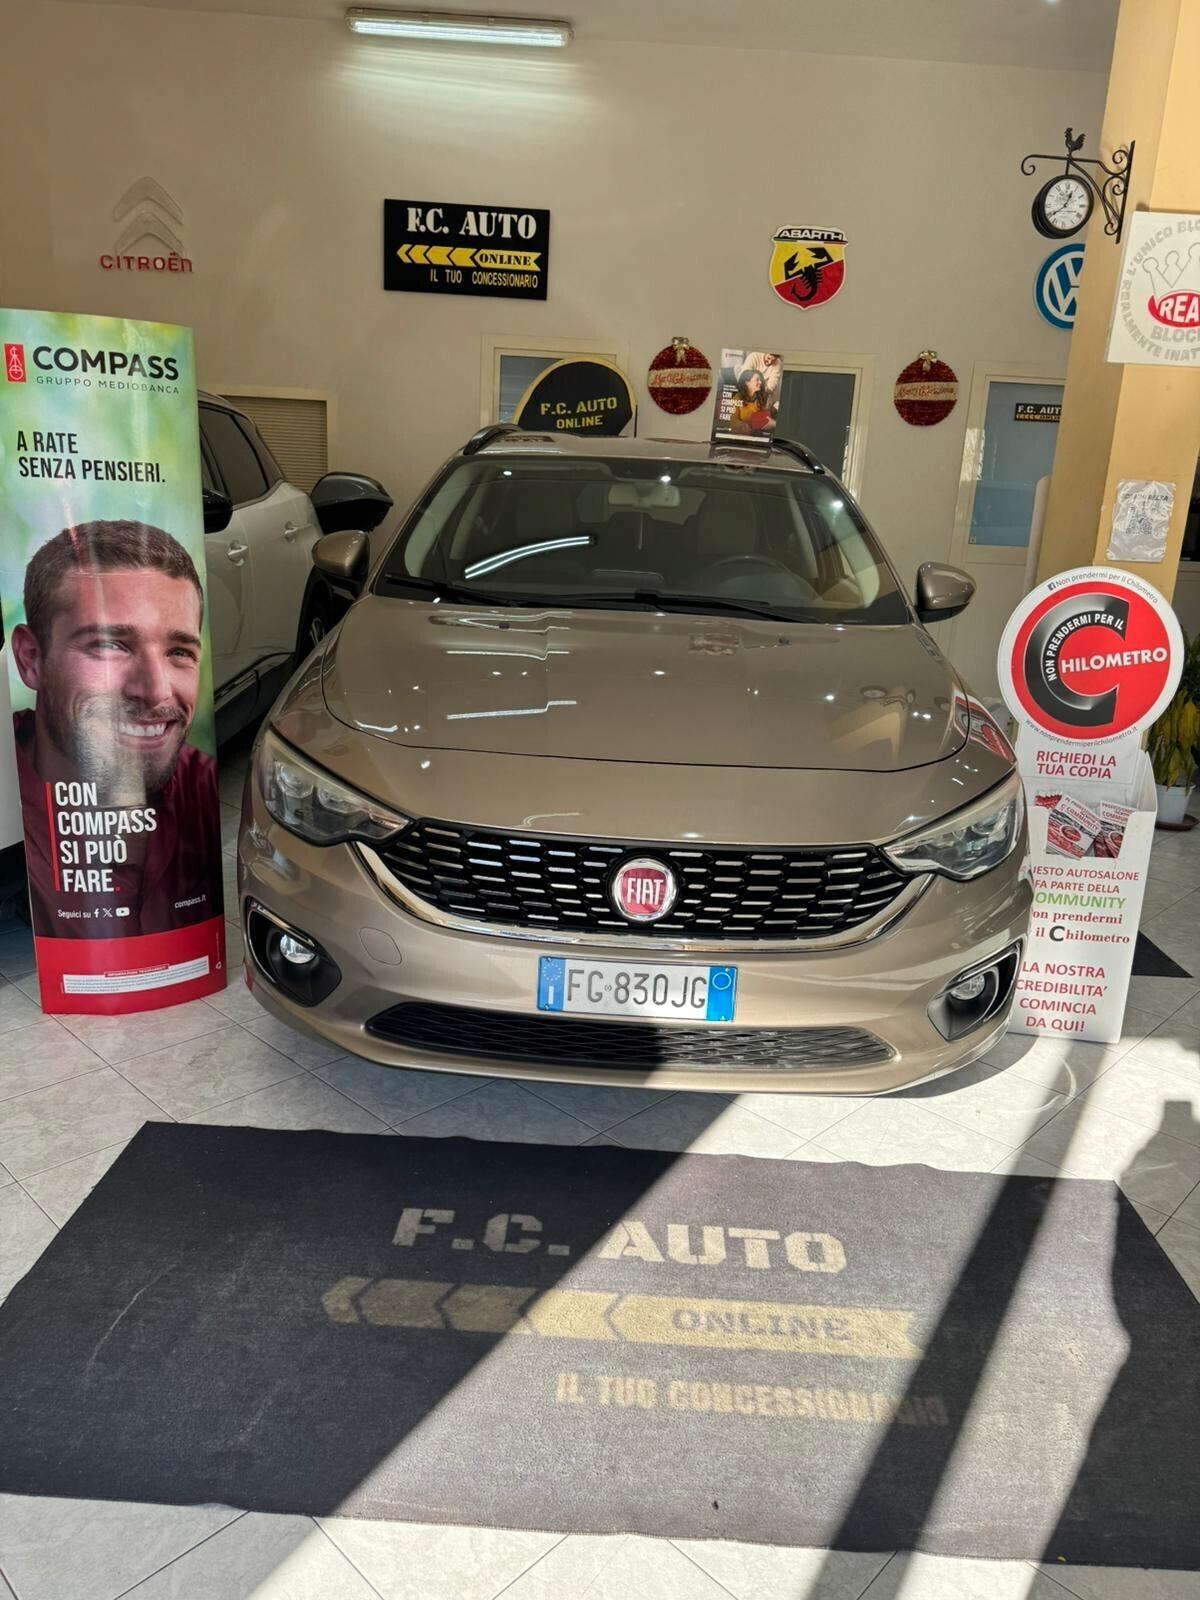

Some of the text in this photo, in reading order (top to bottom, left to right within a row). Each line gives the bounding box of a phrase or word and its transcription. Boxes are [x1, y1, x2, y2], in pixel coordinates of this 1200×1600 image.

[406, 207, 537, 239] F.C. AUTO
[779, 229, 842, 240] ABARTH
[479, 253, 531, 266] ONLINE
[430, 268, 539, 289] IL TUO CONCESSIONARIO
[1151, 325, 1200, 343] BLOC
[32, 346, 180, 381] COMPASS
[37, 376, 180, 394] GRUPPO MEDIOBANCA
[540, 397, 618, 416] F.C. AUTO
[1040, 406, 1061, 414] AUT
[556, 415, 603, 430] ONLINE
[17, 431, 78, 454] A RATE
[18, 456, 166, 483] SENZA PENSIERI.
[1055, 578, 1071, 587] Non
[1071, 572, 1108, 583] prendermi
[1109, 574, 1120, 583] per
[1045, 613, 1124, 682] NON PRENDERMI PER IL
[1036, 750, 1117, 767] RICHIEDI LA
[1037, 763, 1112, 779] TUA COPIA
[54, 781, 98, 807] CON
[57, 808, 158, 836] COMPASS
[59, 834, 128, 864] SI PUÒ
[1066, 868, 1140, 881] AUTOSALONE
[627, 877, 664, 905] FIAT
[1051, 880, 1084, 892] PARTE
[1087, 883, 1120, 894] DELLA
[174, 894, 207, 909] compass.it
[1035, 891, 1127, 909] OMMUNITY
[57, 908, 82, 920] Seguici
[83, 911, 92, 919] su
[1032, 910, 1123, 924] on prendermi
[1036, 926, 1130, 944] il Chilometro
[1022, 961, 1106, 979] LA NOSTRA
[1019, 997, 1097, 1015] COMINCIA
[1026, 1016, 1085, 1032] DA QUI!
[392, 1208, 848, 1275] F.C. AUTO
[671, 1308, 851, 1341] ONLINE
[556, 1372, 583, 1405] IL
[597, 1376, 658, 1409] TUO
